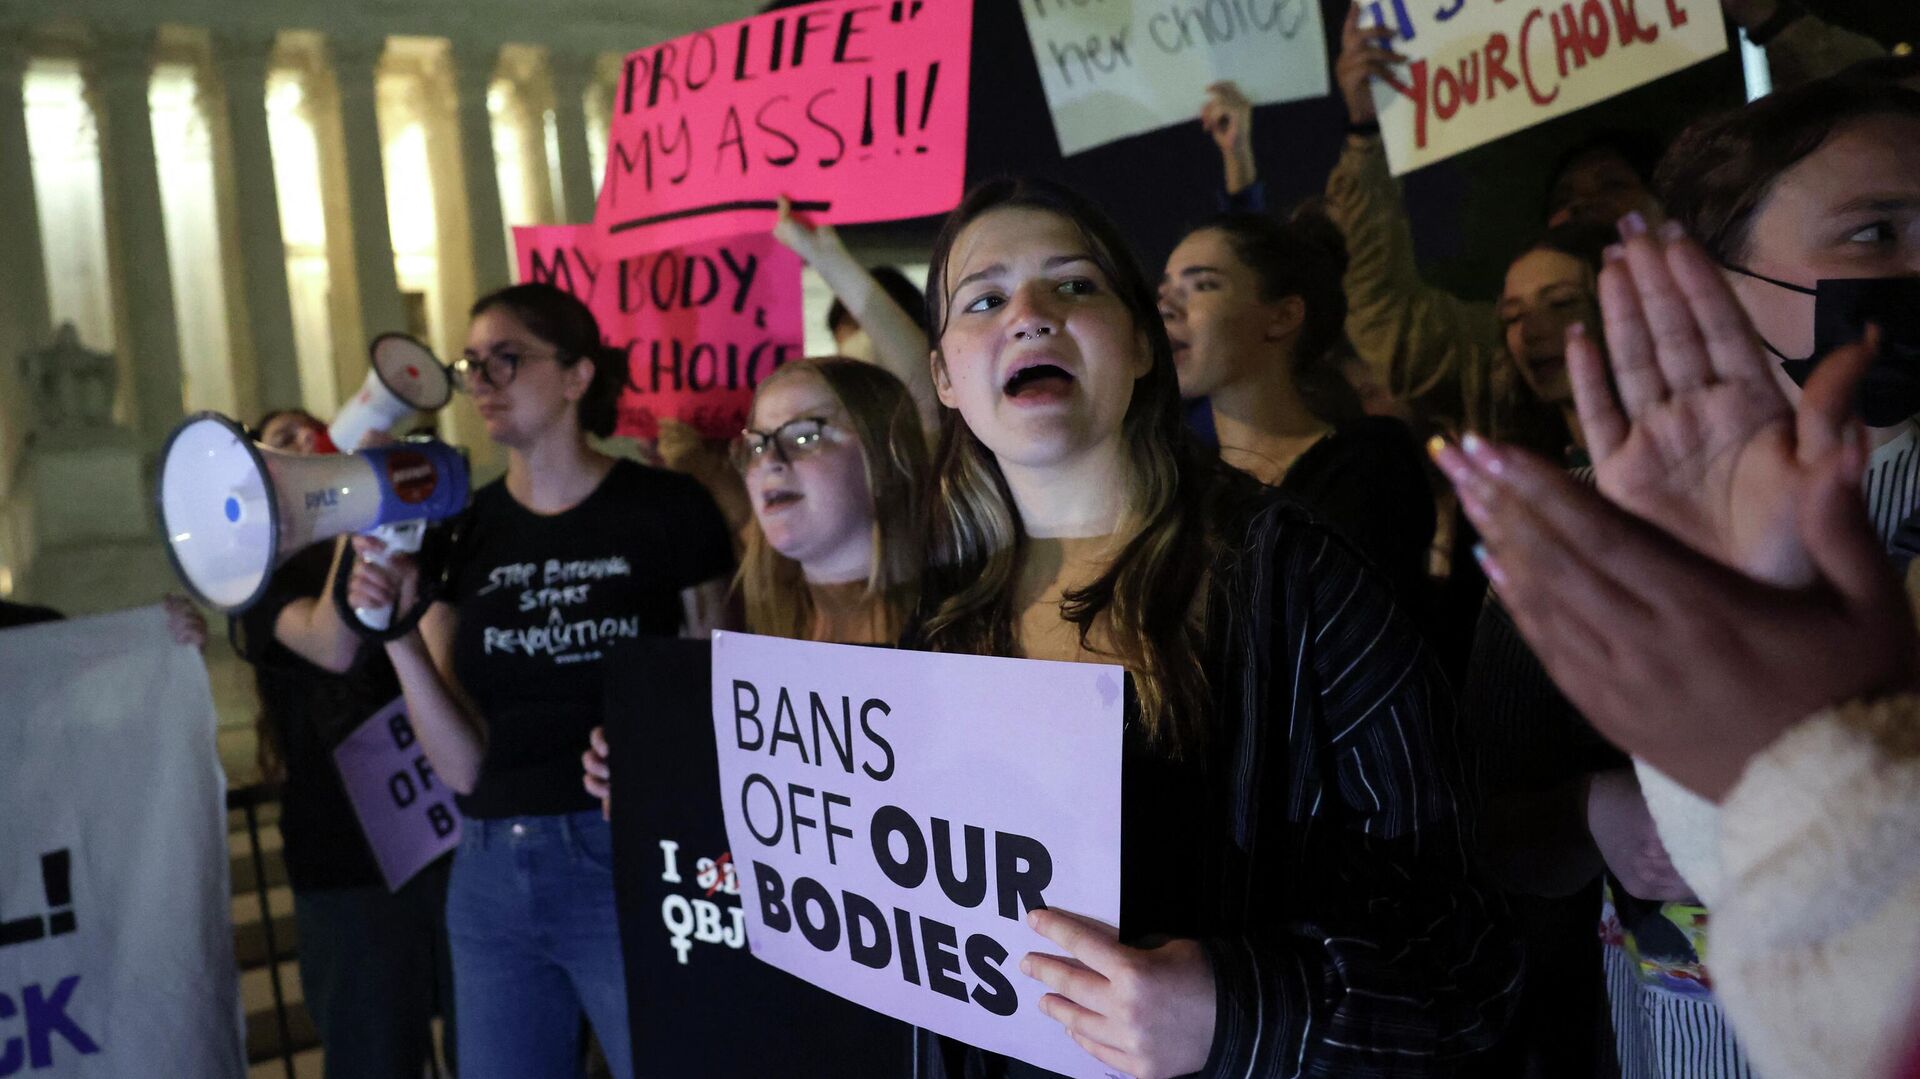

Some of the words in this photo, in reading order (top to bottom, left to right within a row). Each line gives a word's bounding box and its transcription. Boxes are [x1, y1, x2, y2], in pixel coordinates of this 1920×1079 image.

[622, 31, 717, 115] PRO
[1048, 22, 1133, 87] her
[1150, 0, 1309, 55] choice
[610, 115, 692, 208] MY
[715, 61, 941, 175] ASS!!!
[477, 562, 538, 597] STOP
[518, 583, 591, 612] START
[548, 606, 564, 627] A
[483, 615, 639, 657] REVOLUTION
[732, 679, 896, 782] BANS
[659, 839, 682, 884] I
[741, 772, 854, 866] OFF
[870, 804, 1054, 921] OUR
[752, 859, 1019, 1017] BODIES
